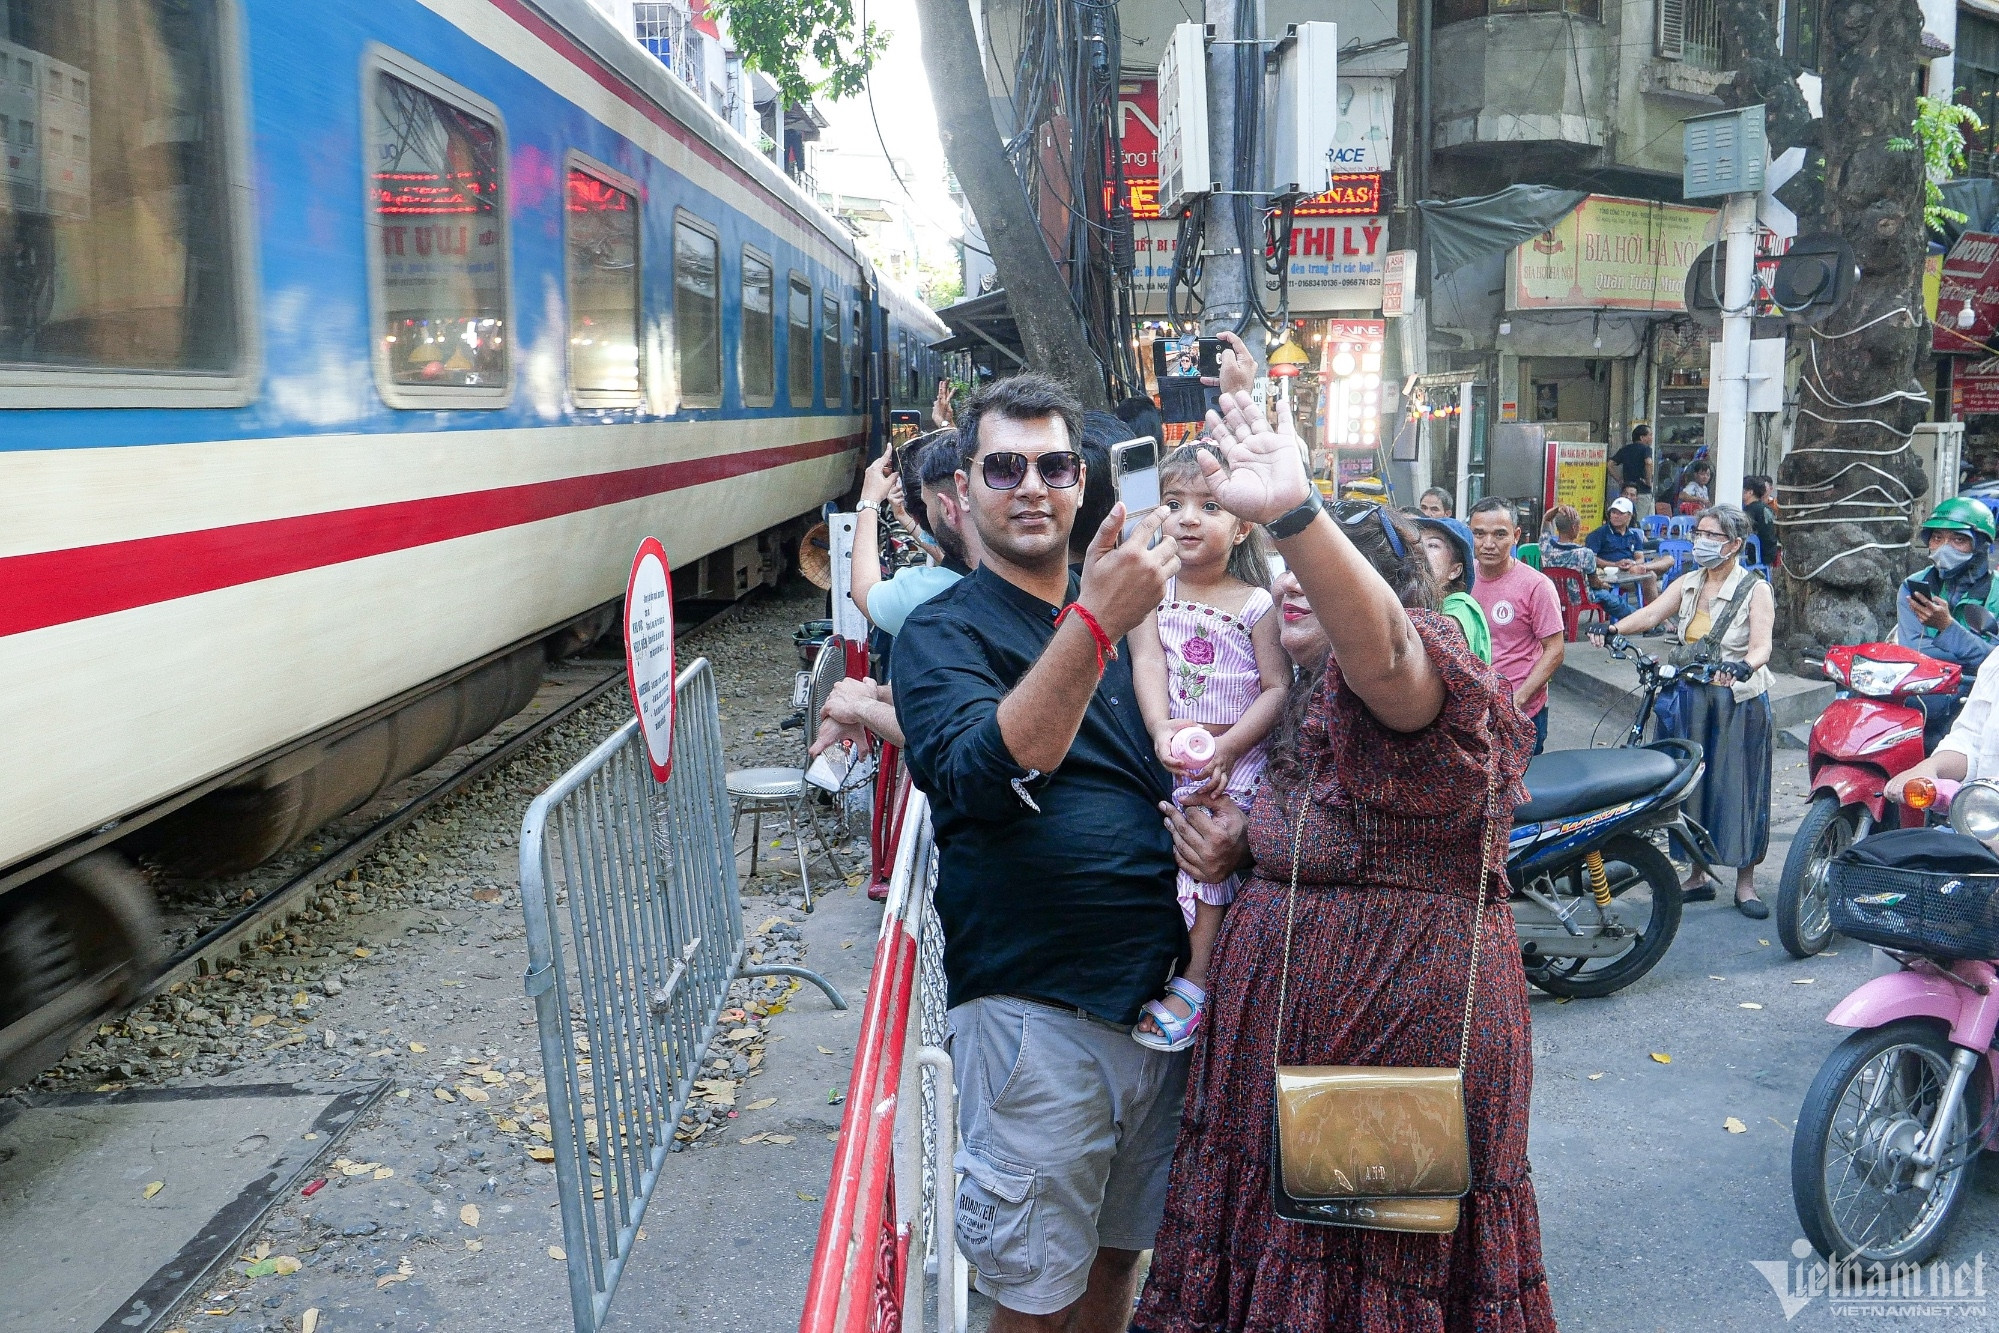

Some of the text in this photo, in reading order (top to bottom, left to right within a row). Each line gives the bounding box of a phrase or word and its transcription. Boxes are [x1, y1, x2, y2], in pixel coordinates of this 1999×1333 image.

[1343, 218, 1382, 256] LÝ
[1585, 233, 1611, 263] BIA
[959, 1193, 996, 1222] ROADSTER
